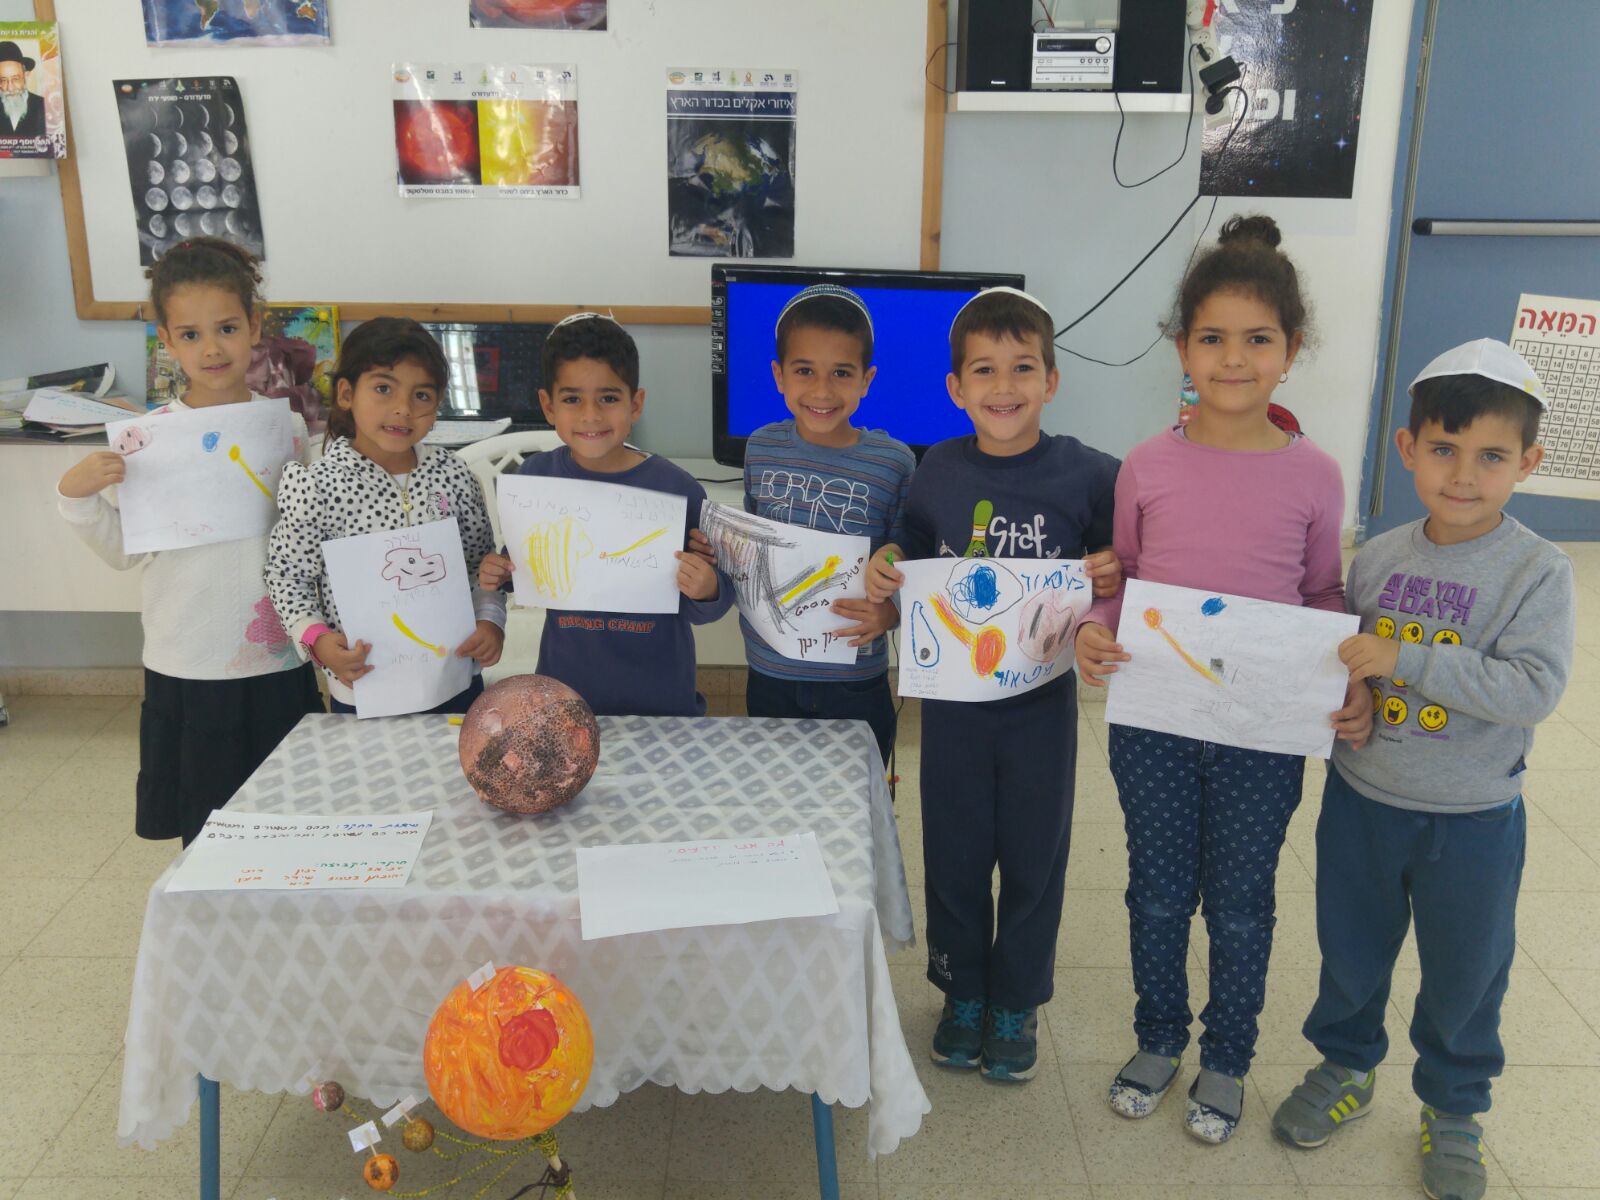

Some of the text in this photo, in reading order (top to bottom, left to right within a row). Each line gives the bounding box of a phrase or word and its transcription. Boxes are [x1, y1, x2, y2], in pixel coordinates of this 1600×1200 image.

[670, 97, 699, 110] הארץ
[702, 97, 731, 109] בכדור
[733, 97, 766, 111] אקלים
[1436, 580, 1479, 610] YOU
